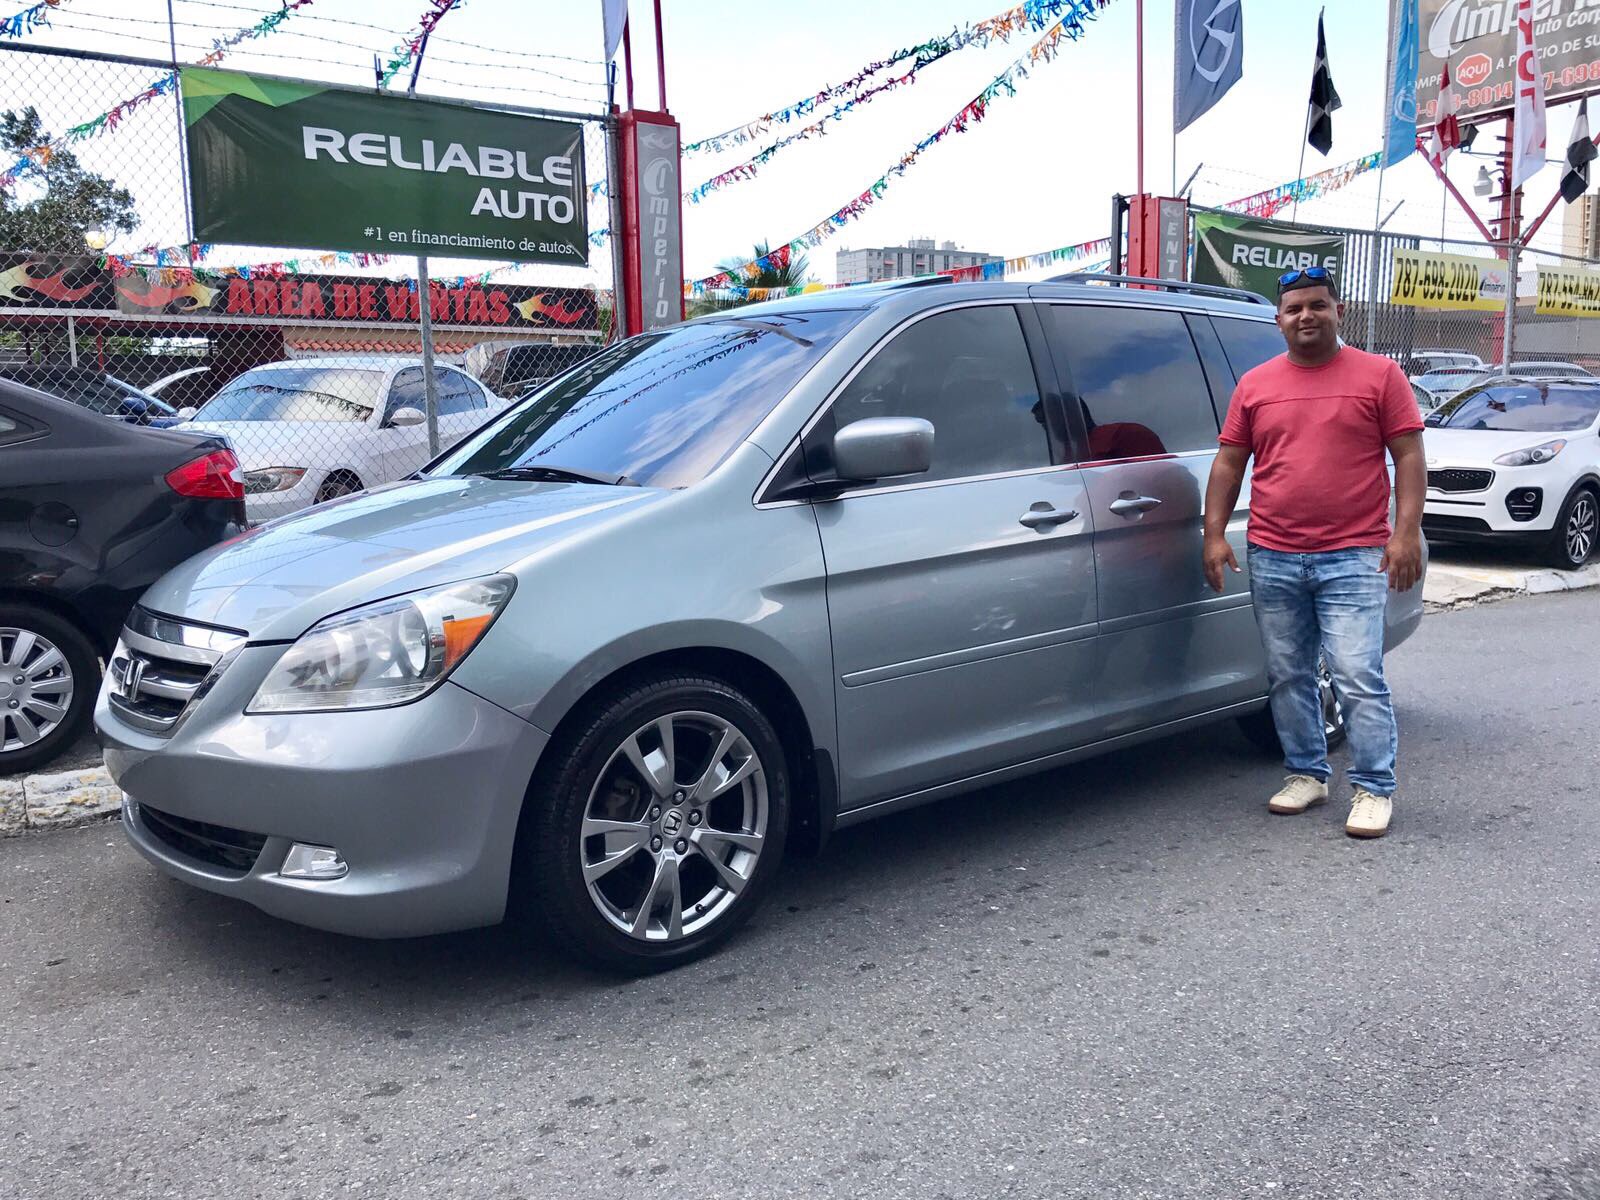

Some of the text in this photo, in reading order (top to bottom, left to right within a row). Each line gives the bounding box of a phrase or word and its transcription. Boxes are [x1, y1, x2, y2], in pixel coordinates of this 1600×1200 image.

[1536, 18, 1562, 36] uto
[1458, 62, 1489, 80] AQUI
[1496, 58, 1505, 70] A
[1562, 37, 1582, 54] DE
[302, 125, 573, 187] RELIABLE
[470, 187, 574, 225] AUTO
[363, 226, 384, 242] #1
[388, 231, 409, 244] en
[411, 228, 515, 251] financiamiento
[518, 237, 536, 252] de
[1166, 222, 1179, 281] ENT
[1231, 243, 1337, 275] RELIABLE
[225, 278, 326, 317] AREA
[332, 283, 379, 319] DE
[1394, 257, 1479, 303] 787-698-2020
